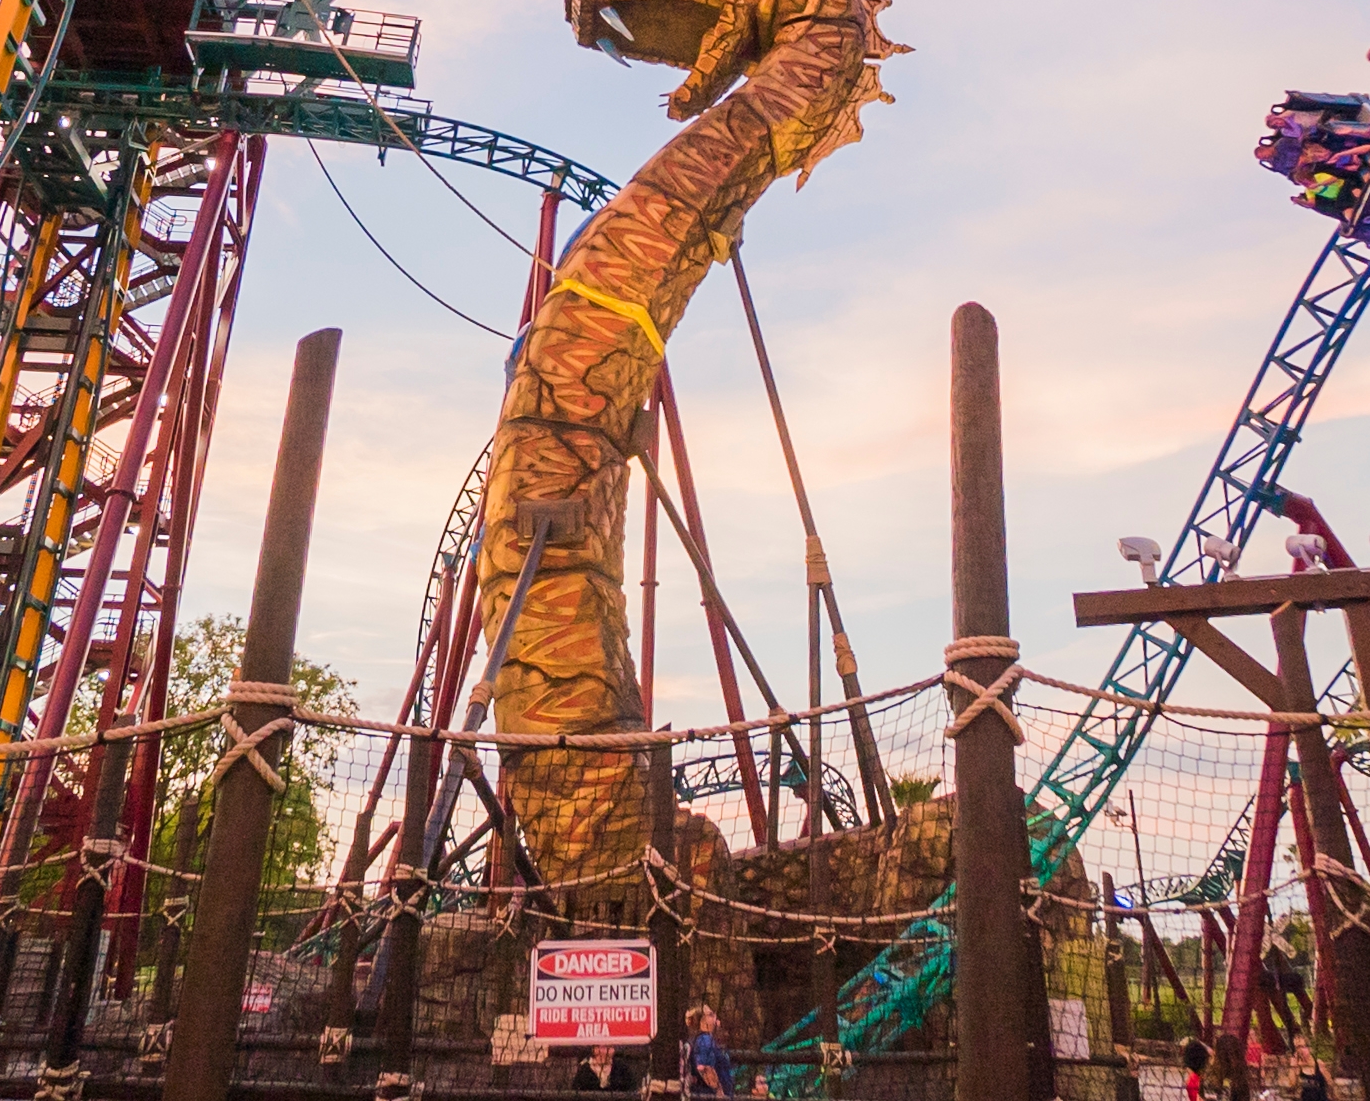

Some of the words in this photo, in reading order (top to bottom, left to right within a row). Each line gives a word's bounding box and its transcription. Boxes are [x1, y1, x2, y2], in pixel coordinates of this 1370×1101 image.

[554, 952, 633, 974] DANGER
[535, 985, 558, 1002] DO
[562, 984, 594, 1002] NOT
[599, 984, 650, 1001] ENTER
[539, 1008, 568, 1023] RIDE
[571, 1007, 648, 1023] RESTRICTED
[576, 1022, 610, 1037] AREA
